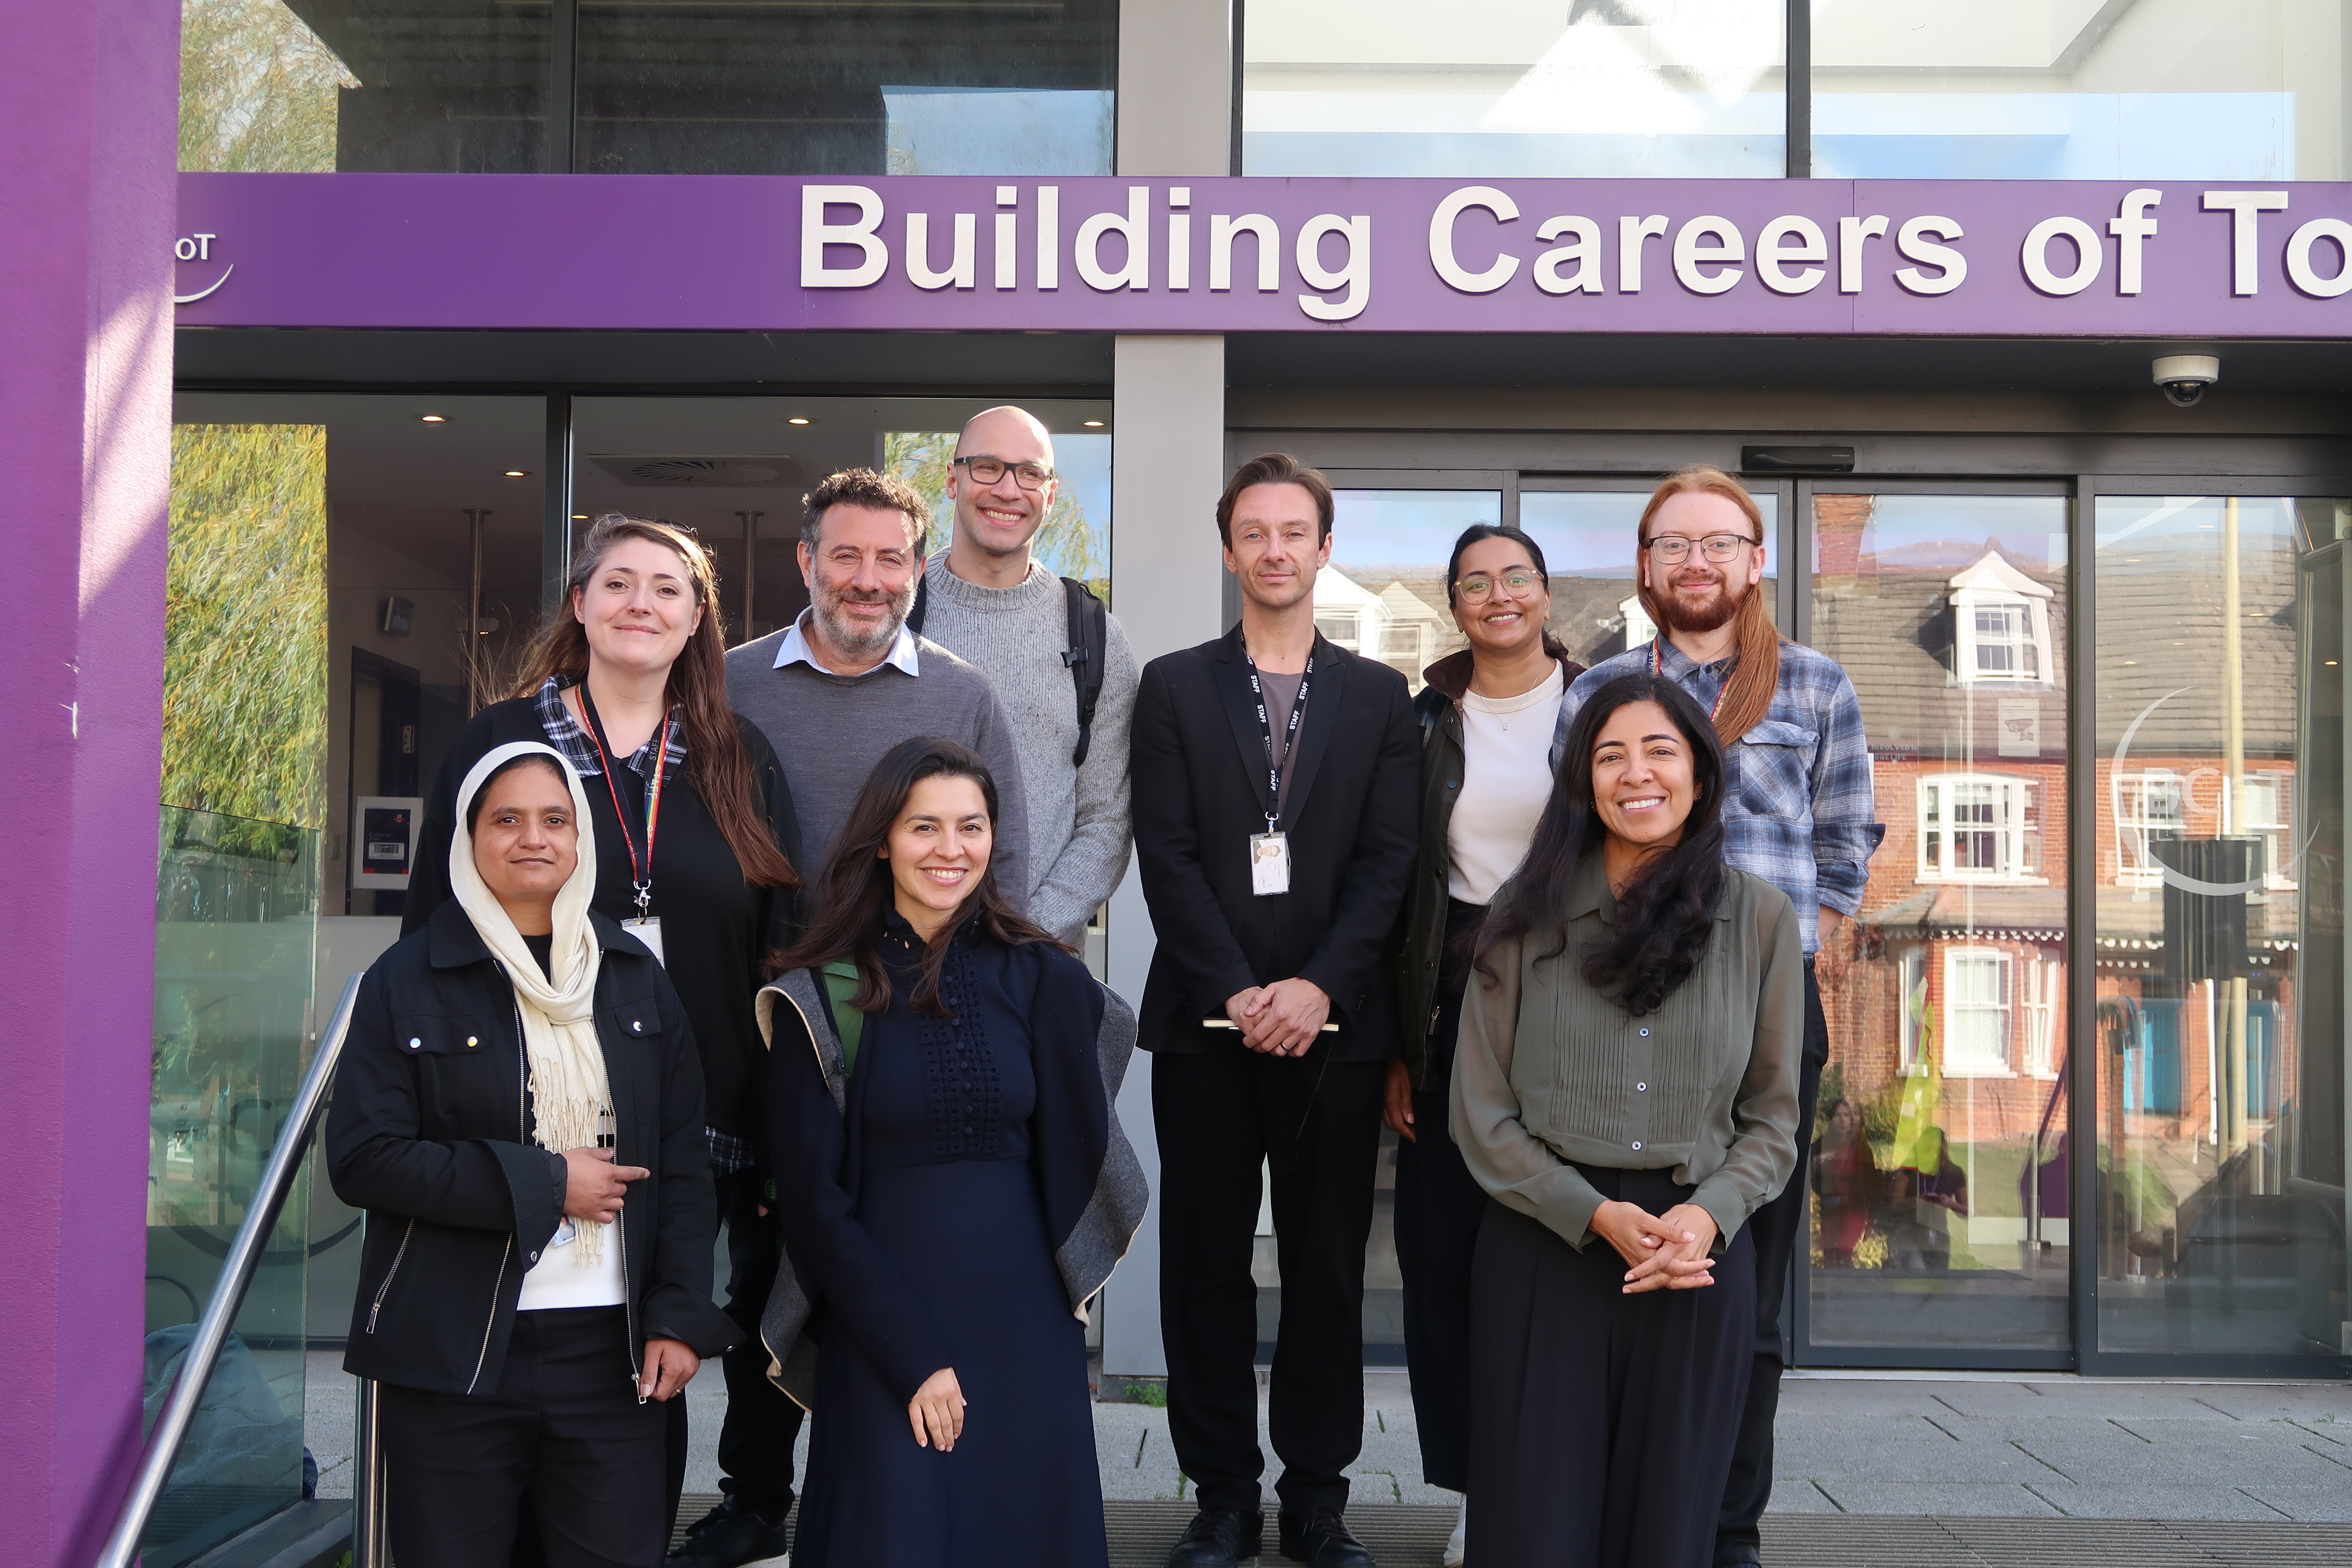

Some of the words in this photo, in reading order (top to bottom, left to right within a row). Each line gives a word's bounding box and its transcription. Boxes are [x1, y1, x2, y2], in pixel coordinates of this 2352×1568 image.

[175, 233, 216, 260] oT
[801, 185, 1370, 319] Building
[1430, 186, 1967, 293] Careers
[2023, 189, 2162, 294] of
[2204, 191, 2352, 296] To
[1649, 649, 1658, 673] STAF
[1251, 675, 1260, 693] STAFF
[1299, 681, 1309, 700] STAFF
[1257, 704, 1267, 723] STAFF
[1289, 710, 1300, 730] STAFF
[649, 738, 660, 761] STAFF
